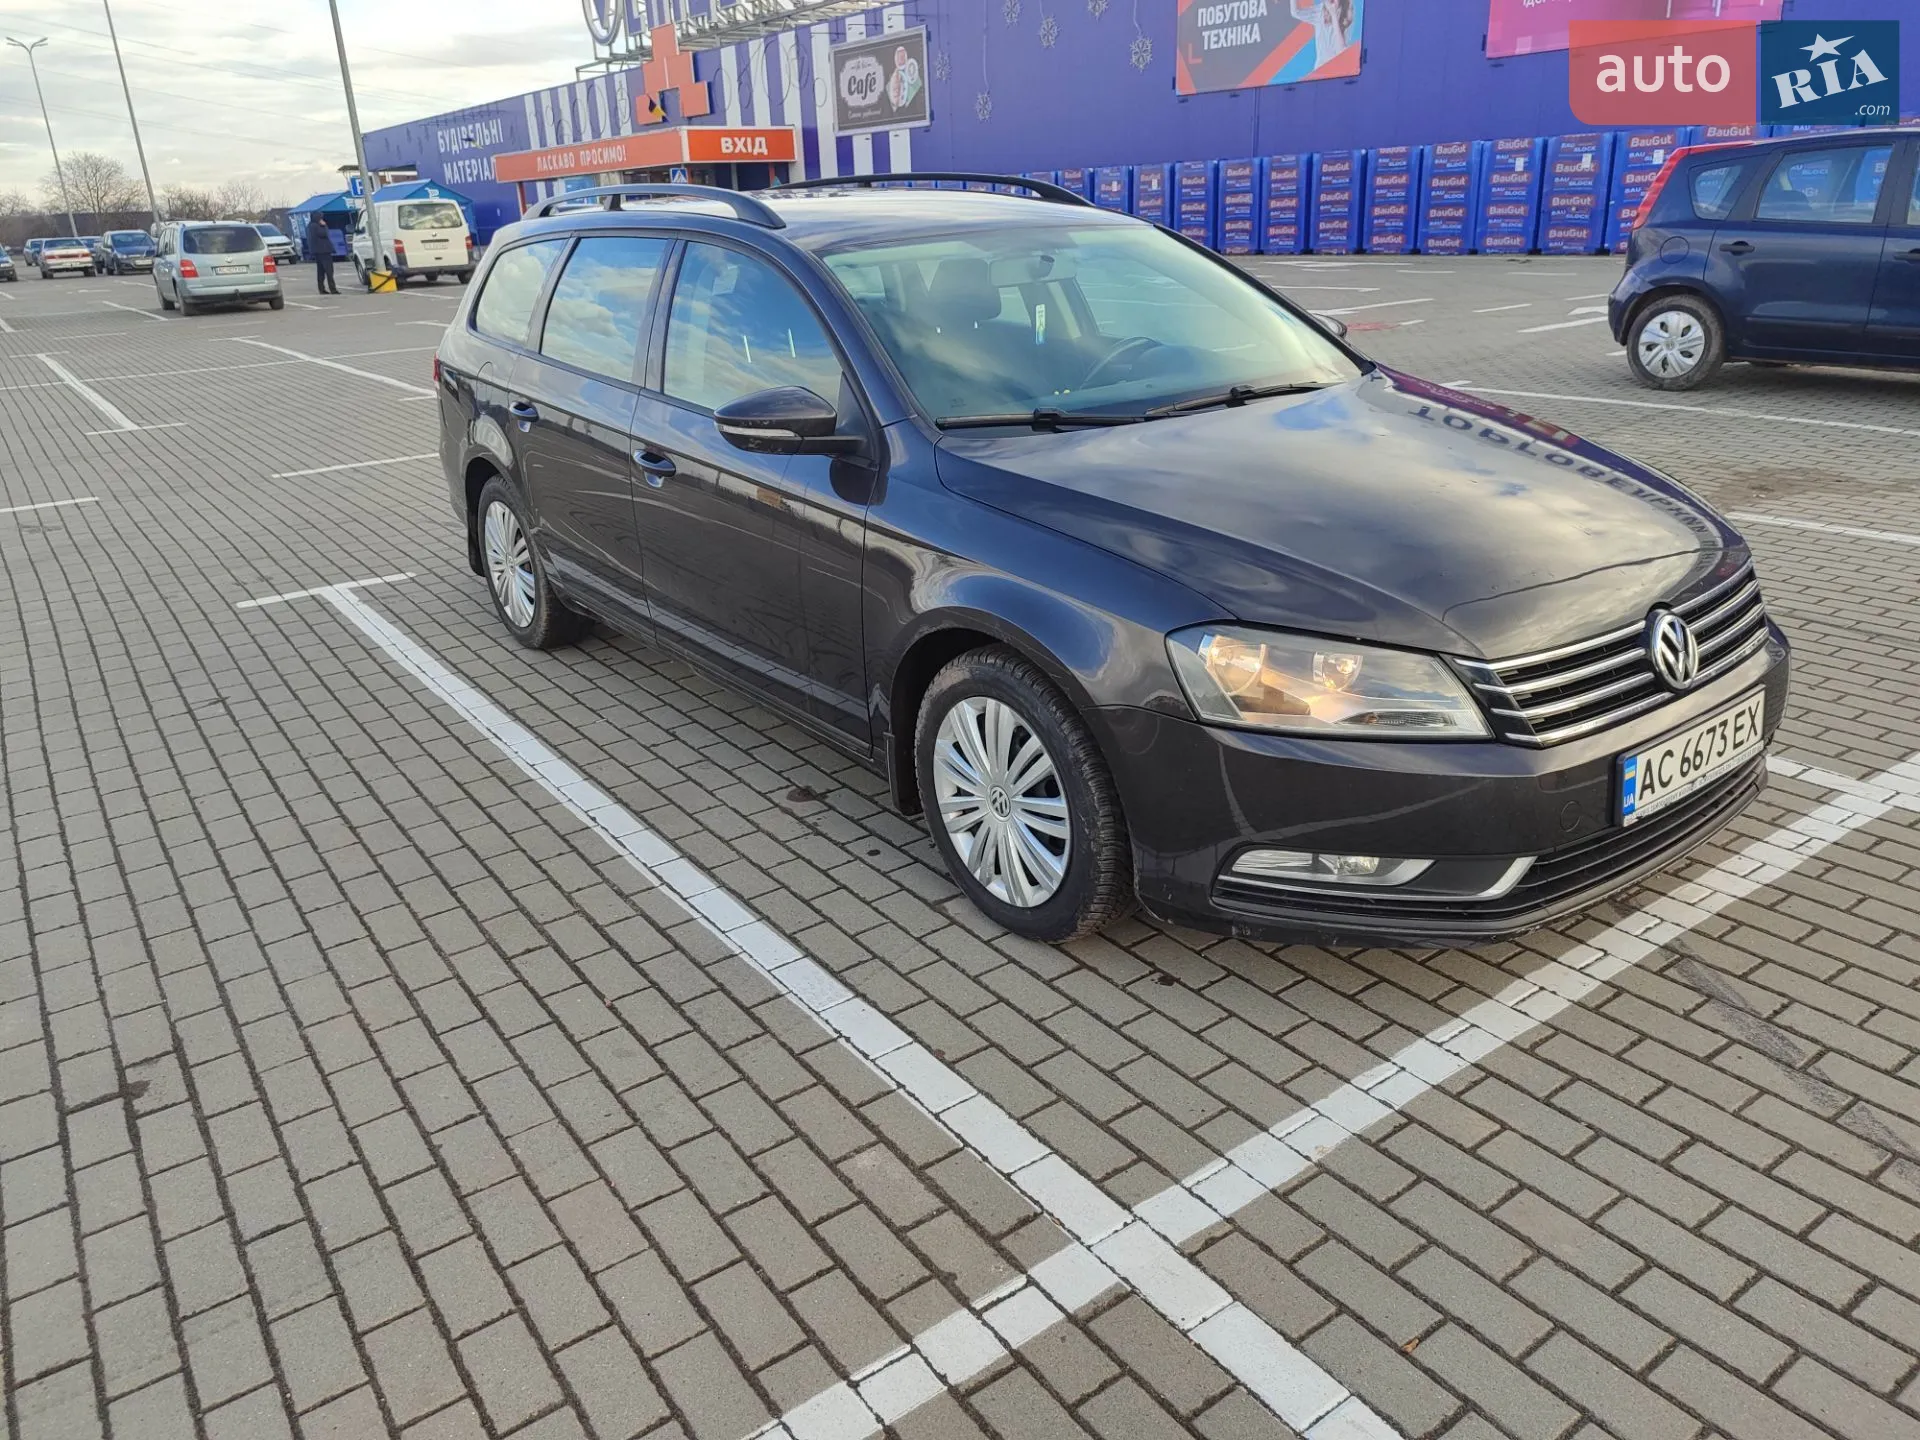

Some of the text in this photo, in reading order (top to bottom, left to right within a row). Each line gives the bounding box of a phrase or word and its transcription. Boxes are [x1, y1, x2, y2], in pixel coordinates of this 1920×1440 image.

[1197, 0, 1267, 28] ПОБУТОВА
[1202, 23, 1261, 50] ТЕХНІКА
[847, 72, 877, 101] Café
[437, 118, 504, 155] БУДІВЕЛЬНІ
[1707, 126, 1750, 137] BauGut
[720, 136, 769, 156] ВХІД
[1498, 139, 1529, 150] BauGut
[1630, 135, 1672, 148] BauGut
[1436, 144, 1467, 154] BauGut
[536, 144, 627, 173] ЛАСКАВО ПРОСИМО!
[1376, 176, 1407, 185] BauGut
[1431, 176, 1466, 187] BauGut
[1492, 173, 1528, 183] BauGut
[1552, 196, 1592, 206] BauGut
[1374, 206, 1405, 215] BauGut
[1429, 207, 1464, 218] BauGut
[1489, 205, 1525, 215] BauGut
[1549, 228, 1588, 238] BauGut
[1372, 235, 1402, 244] BauGut
[1427, 238, 1461, 248] BauGut
[1486, 236, 1521, 246] BauGut
[1638, 749, 1674, 801] AC
[1679, 718, 1728, 778] 6673
[1732, 700, 1761, 751] EX
[1623, 792, 1634, 808] UA
